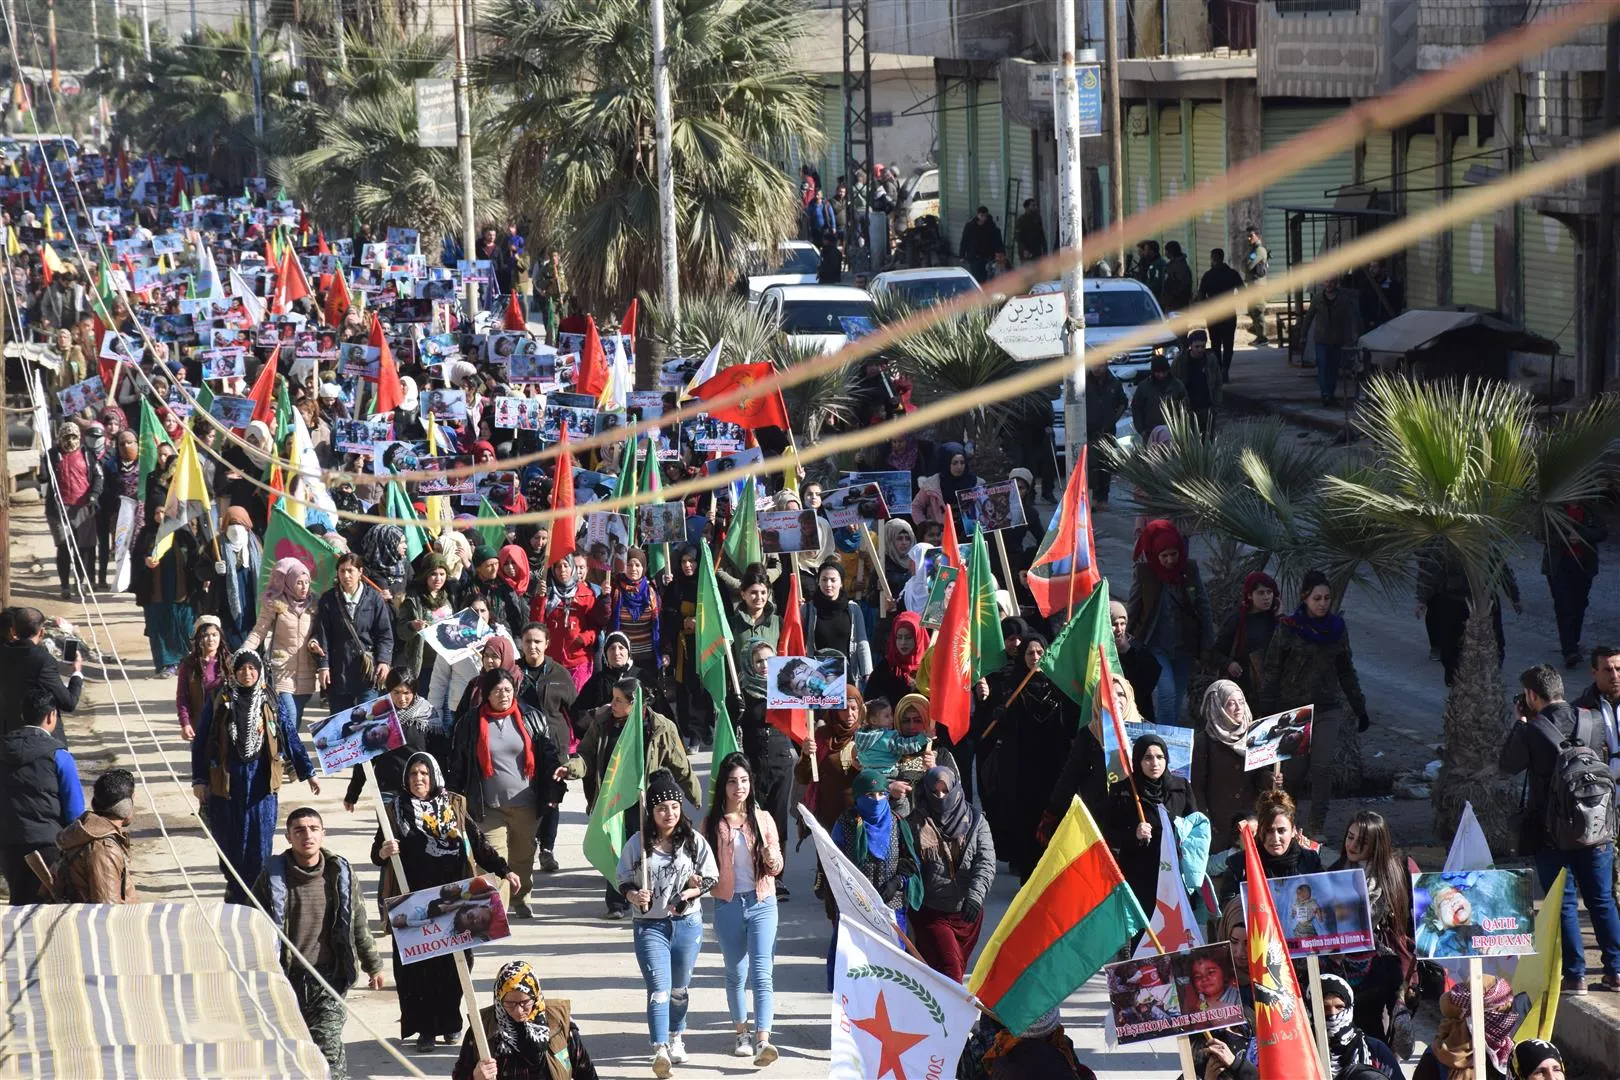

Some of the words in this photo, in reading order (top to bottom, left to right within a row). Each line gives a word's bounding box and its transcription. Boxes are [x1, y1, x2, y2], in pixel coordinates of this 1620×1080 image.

[422, 923, 442, 936] KA
[1482, 917, 1518, 931] QATIL
[404, 930, 473, 958] MIROVATÎ
[1472, 934, 1532, 948] ERDUXAN
[1171, 1014, 1191, 1027] ME
[1190, 1011, 1208, 1024] NE
